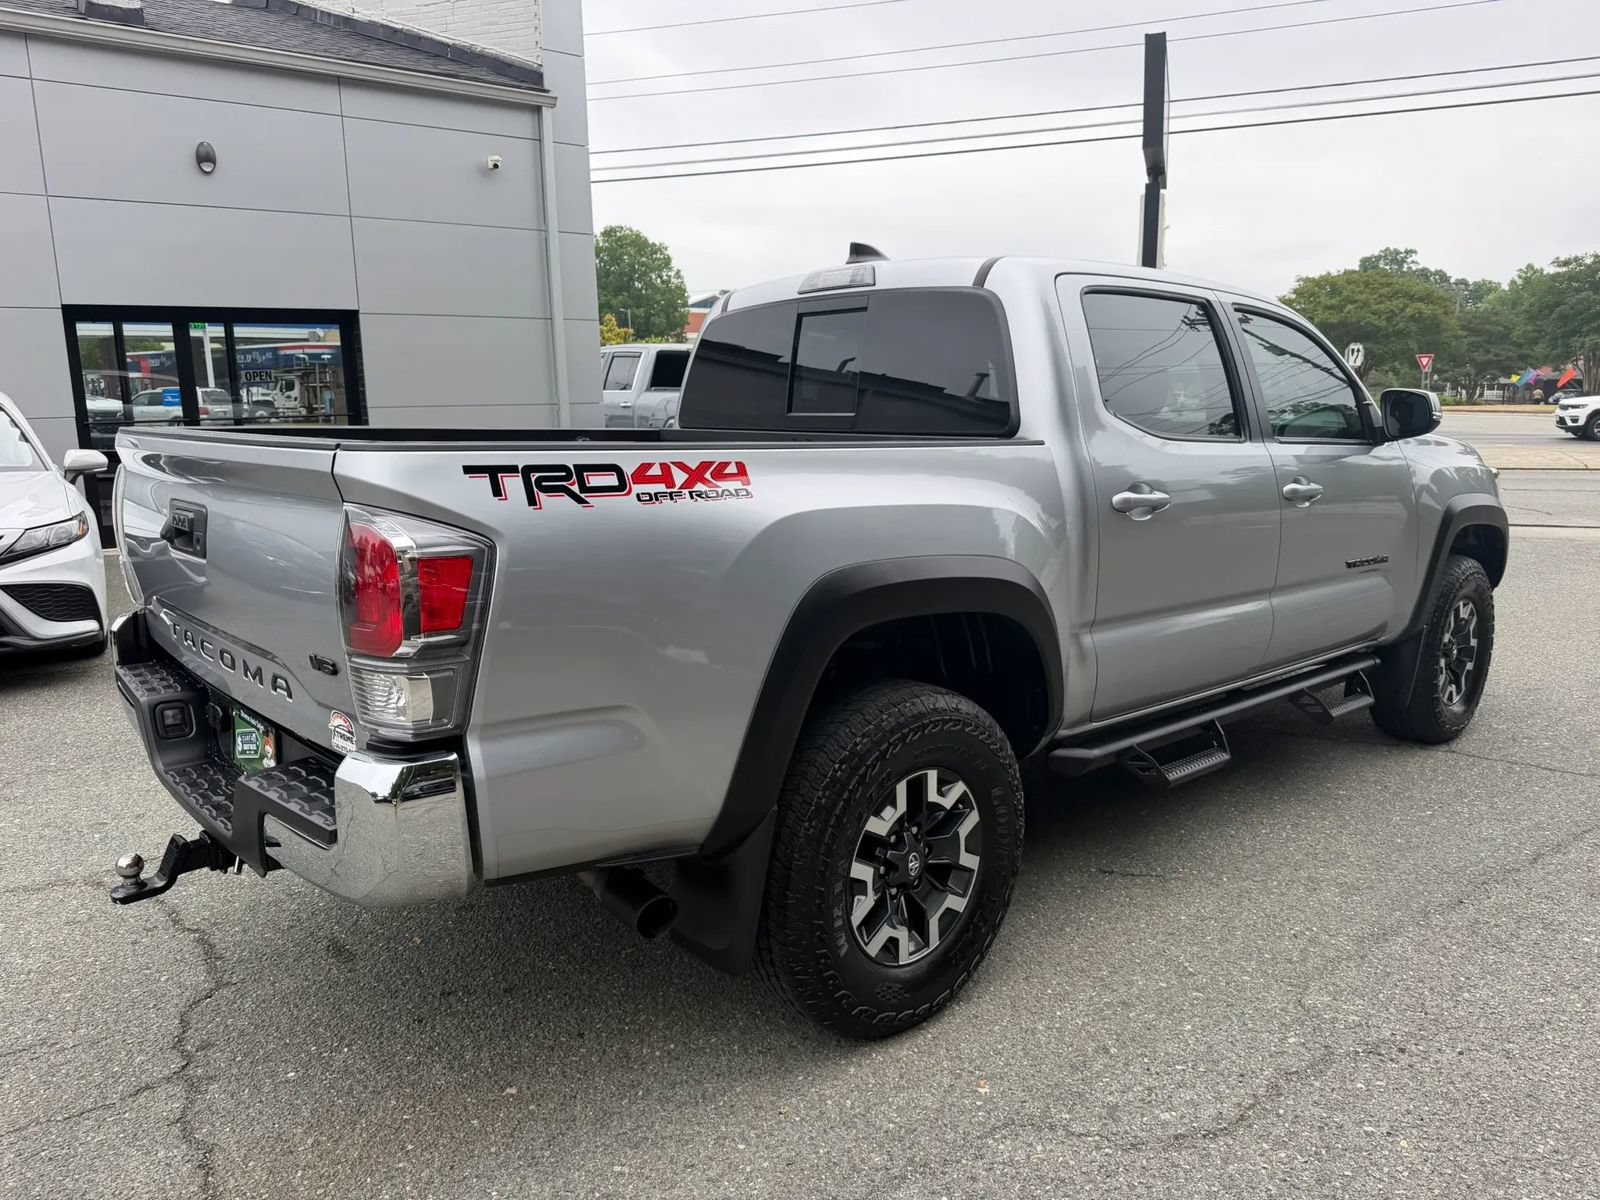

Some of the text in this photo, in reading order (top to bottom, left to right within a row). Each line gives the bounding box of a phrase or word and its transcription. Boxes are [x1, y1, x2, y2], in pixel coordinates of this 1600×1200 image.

[244, 370, 273, 381] OPEN
[462, 464, 632, 510] TRD
[636, 489, 753, 505] OFF ROAD
[170, 620, 293, 703] TACOMA
[308, 653, 339, 676] V6
